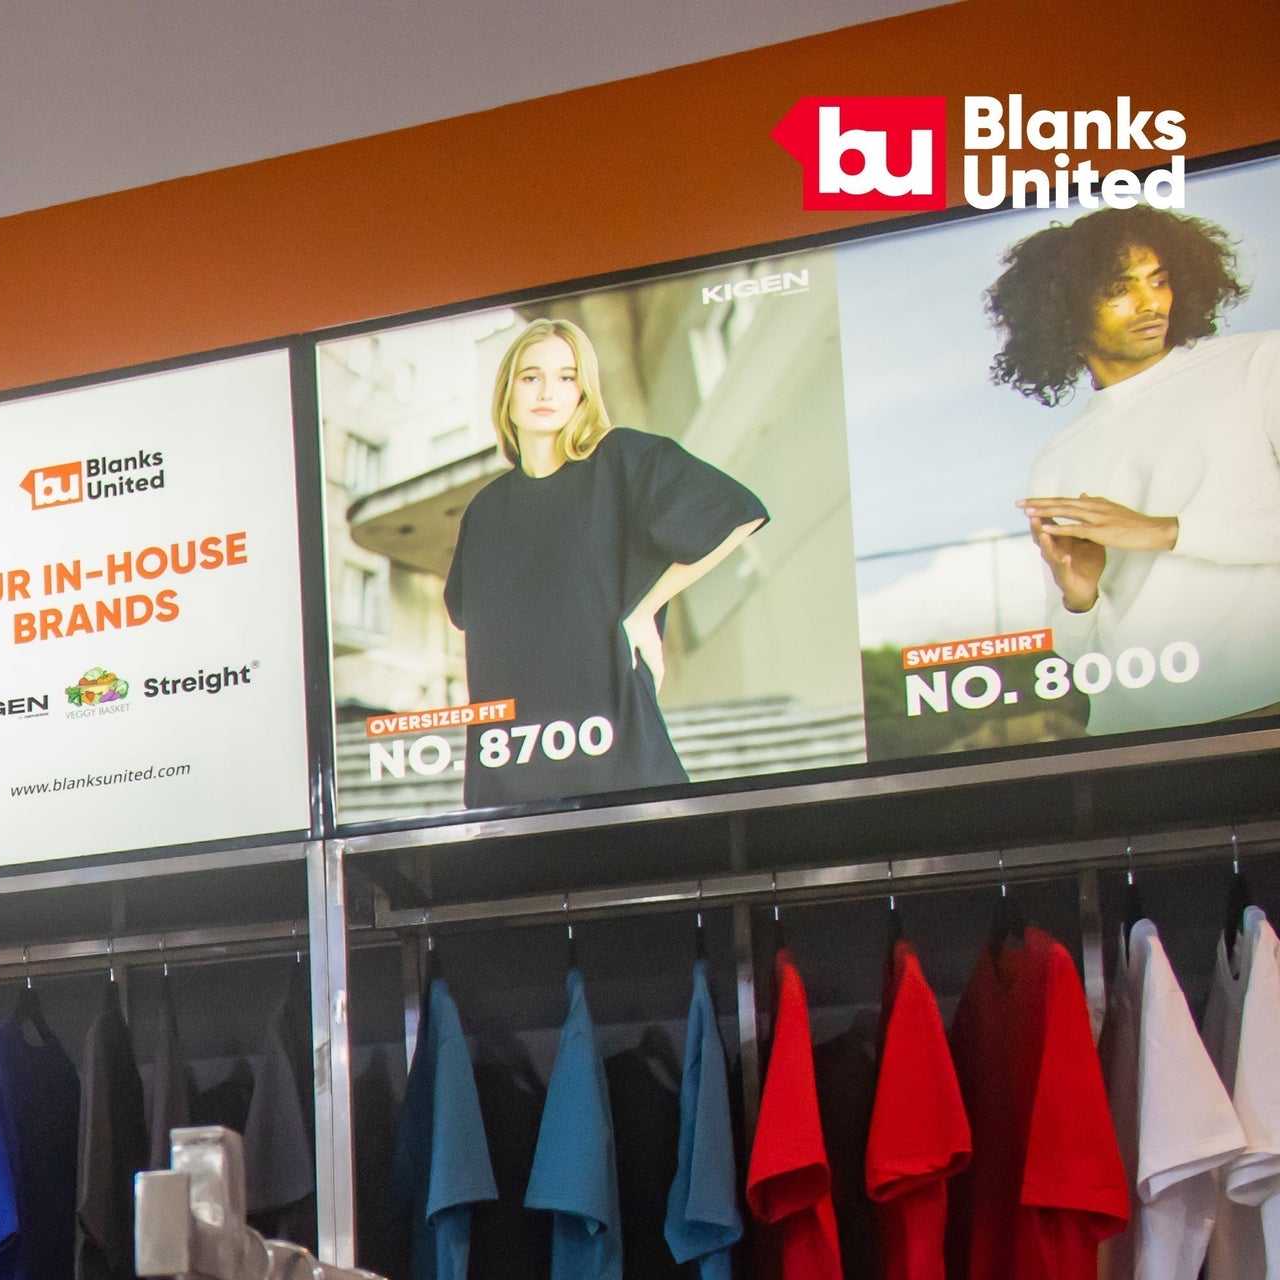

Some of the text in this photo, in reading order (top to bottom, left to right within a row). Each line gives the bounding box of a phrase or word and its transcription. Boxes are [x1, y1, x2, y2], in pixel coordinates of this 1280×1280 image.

[701, 268, 810, 305] KIGEN
[86, 450, 164, 478] Blanks
[34, 471, 80, 507] bu
[87, 469, 165, 500] United
[43, 531, 249, 596] IN-HOUSE
[13, 589, 180, 645] BRANDS
[906, 632, 1047, 666] SWEATSHIRT
[905, 640, 1201, 718] NO. 8000
[65, 709, 96, 723] VEGGY
[98, 703, 131, 717] BASKET
[369, 703, 508, 735] OVERSIZED FIT
[368, 715, 615, 782] NO. 8700
[10, 761, 191, 798] www.blanksunited.com
